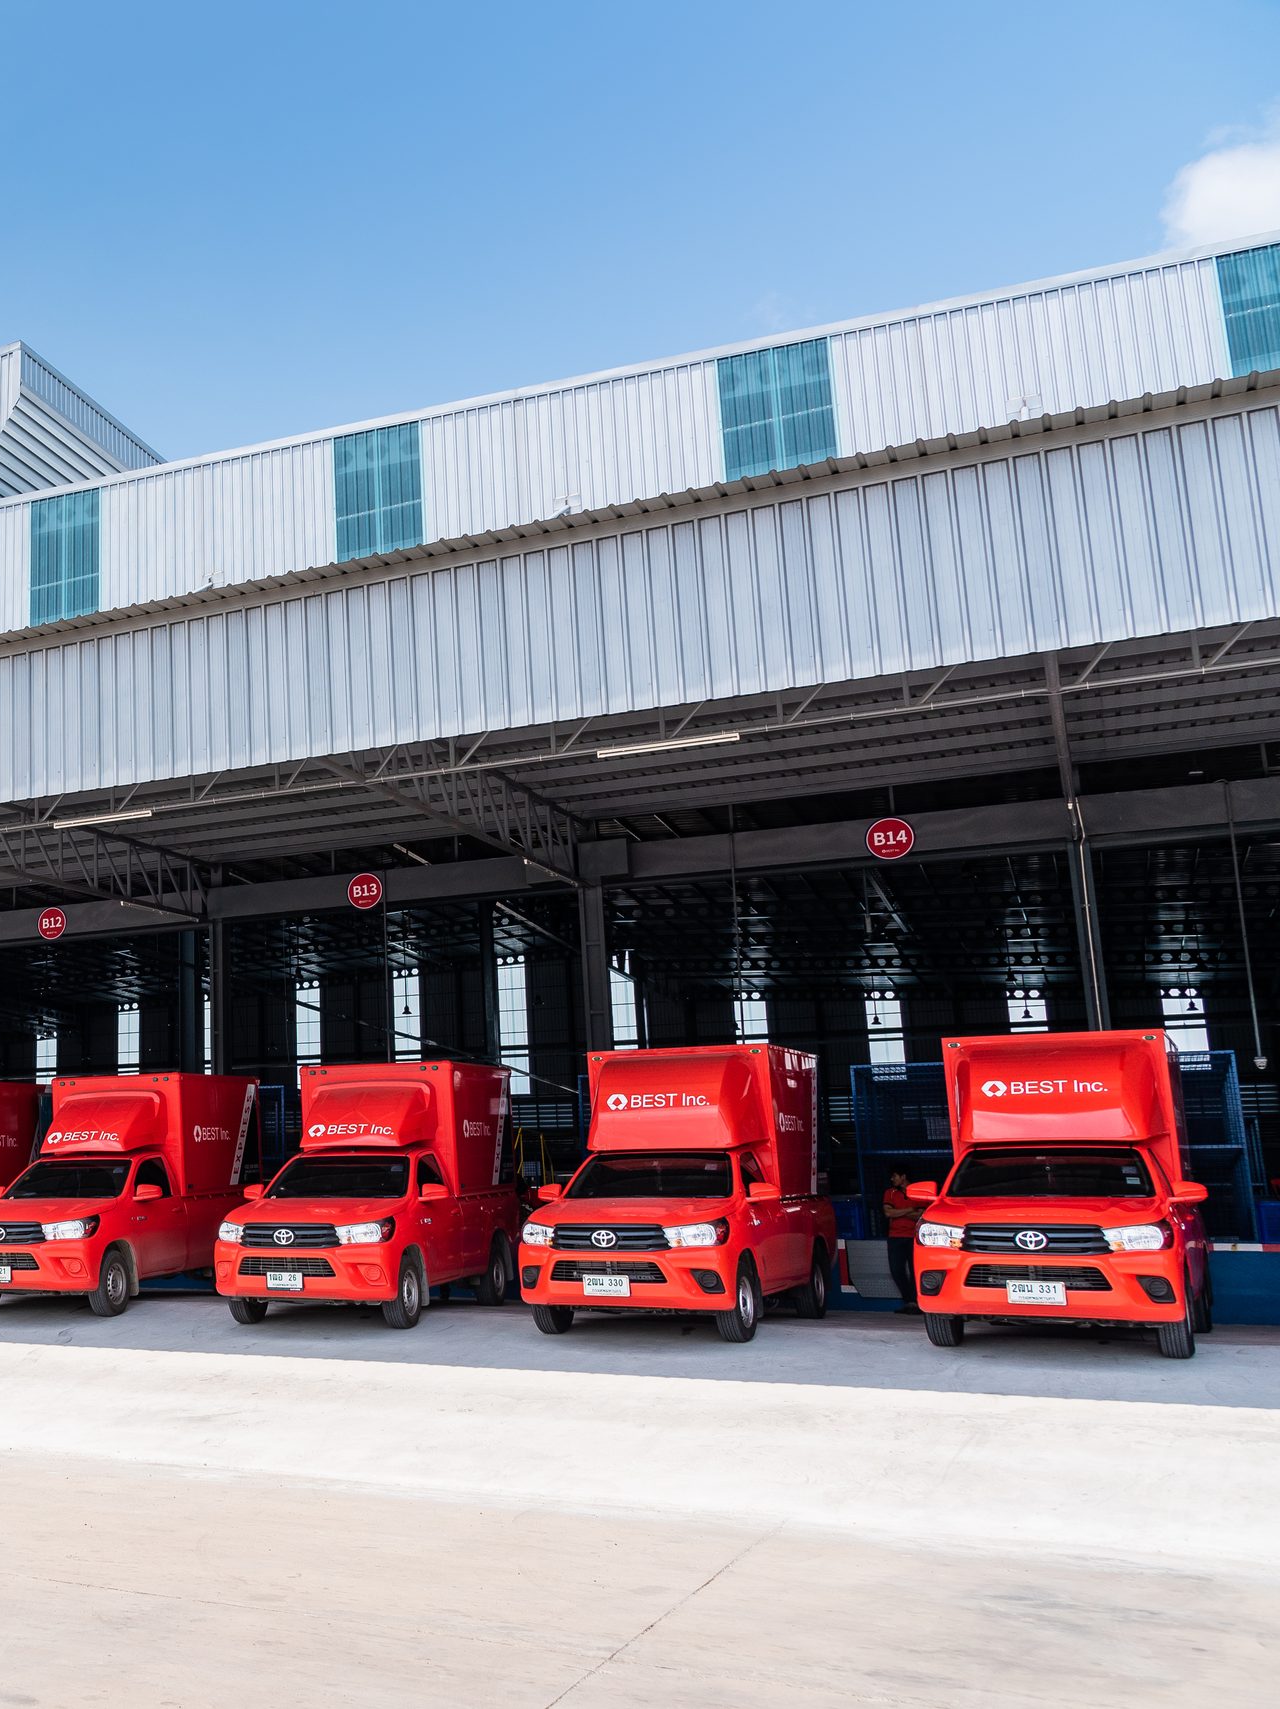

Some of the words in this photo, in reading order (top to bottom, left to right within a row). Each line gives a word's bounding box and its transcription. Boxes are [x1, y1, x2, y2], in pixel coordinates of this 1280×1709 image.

[873, 830, 908, 846] B14
[352, 883, 378, 898] B13
[42, 916, 62, 928] B12
[1010, 1080, 1068, 1095] BEST
[1074, 1080, 1108, 1092] Inc.
[630, 1093, 678, 1108] BEST
[682, 1092, 710, 1106] Inc.
[327, 1124, 368, 1135] BEST
[370, 1124, 395, 1135] Inc.
[469, 1122, 483, 1136] BEST
[784, 1114, 796, 1131] BEST
[6, 1135, 18, 1147] Inc.
[62, 1131, 98, 1142] BEST
[99, 1130, 120, 1141] Inc.
[202, 1127, 219, 1141] BEST
[220, 1128, 231, 1140] Inc.
[234, 1095, 253, 1174] EXPRESS
[608, 1278, 624, 1287] 330
[1038, 1284, 1057, 1294] 331
